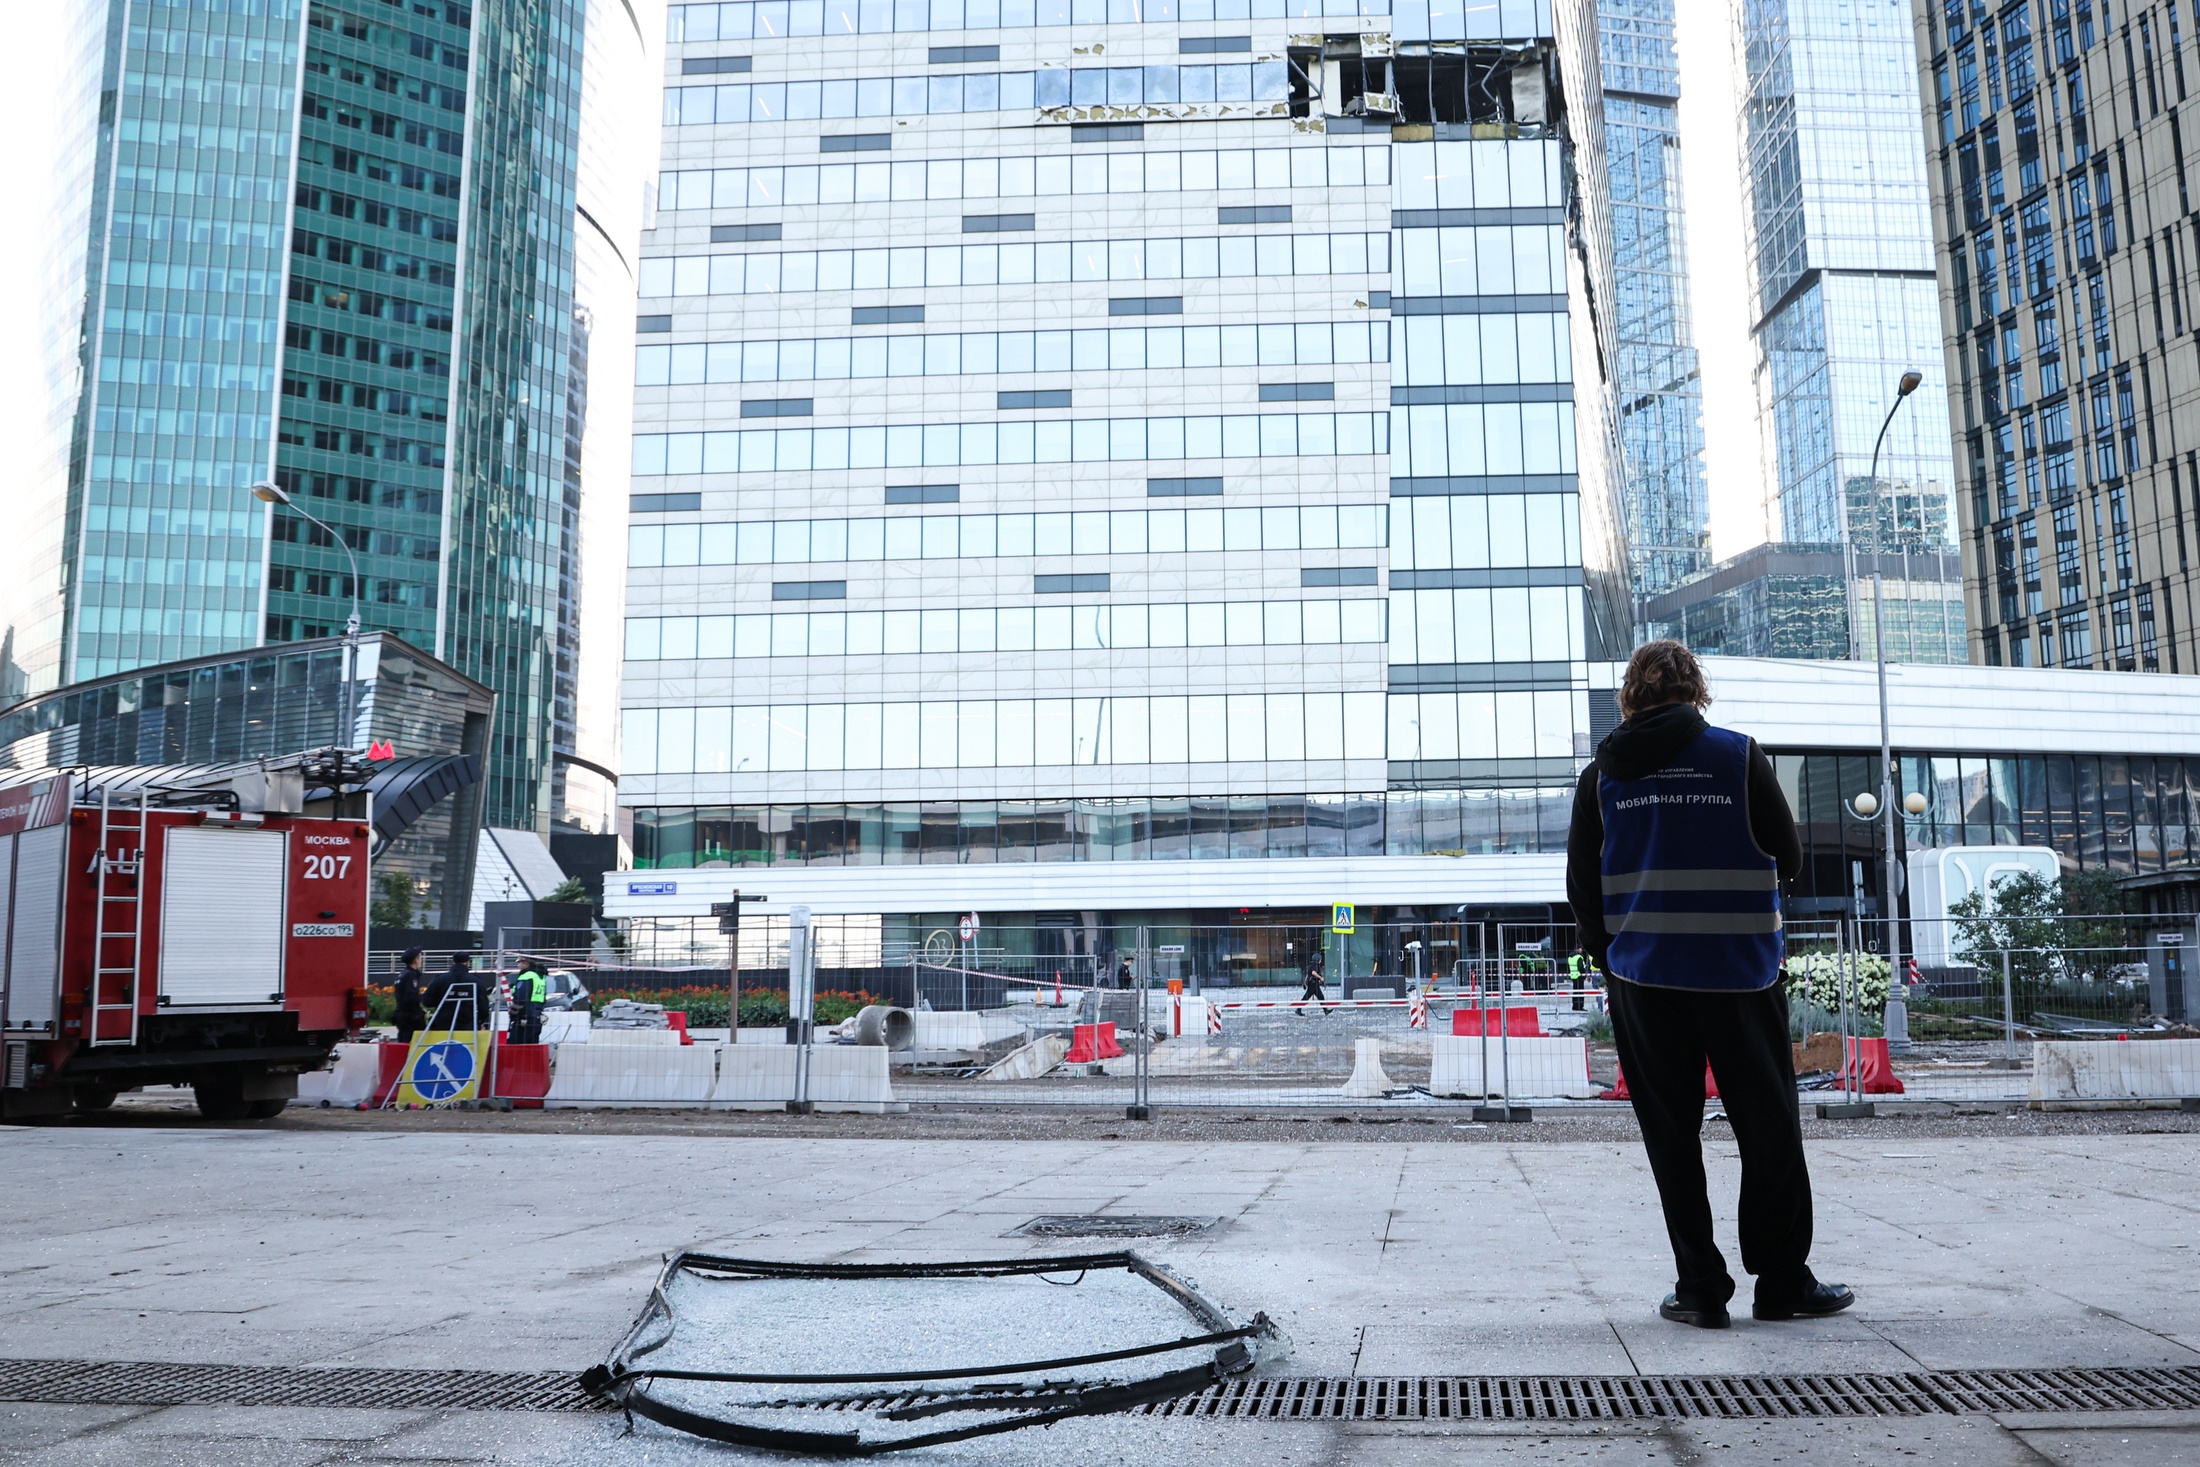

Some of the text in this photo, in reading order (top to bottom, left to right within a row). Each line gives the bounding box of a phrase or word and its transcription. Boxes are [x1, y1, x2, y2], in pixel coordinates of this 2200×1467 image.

[1616, 794, 1732, 810] МОБИЛЬНАЯ ГРУППА
[304, 836, 351, 845] МОСКВА
[303, 855, 352, 879] 207
